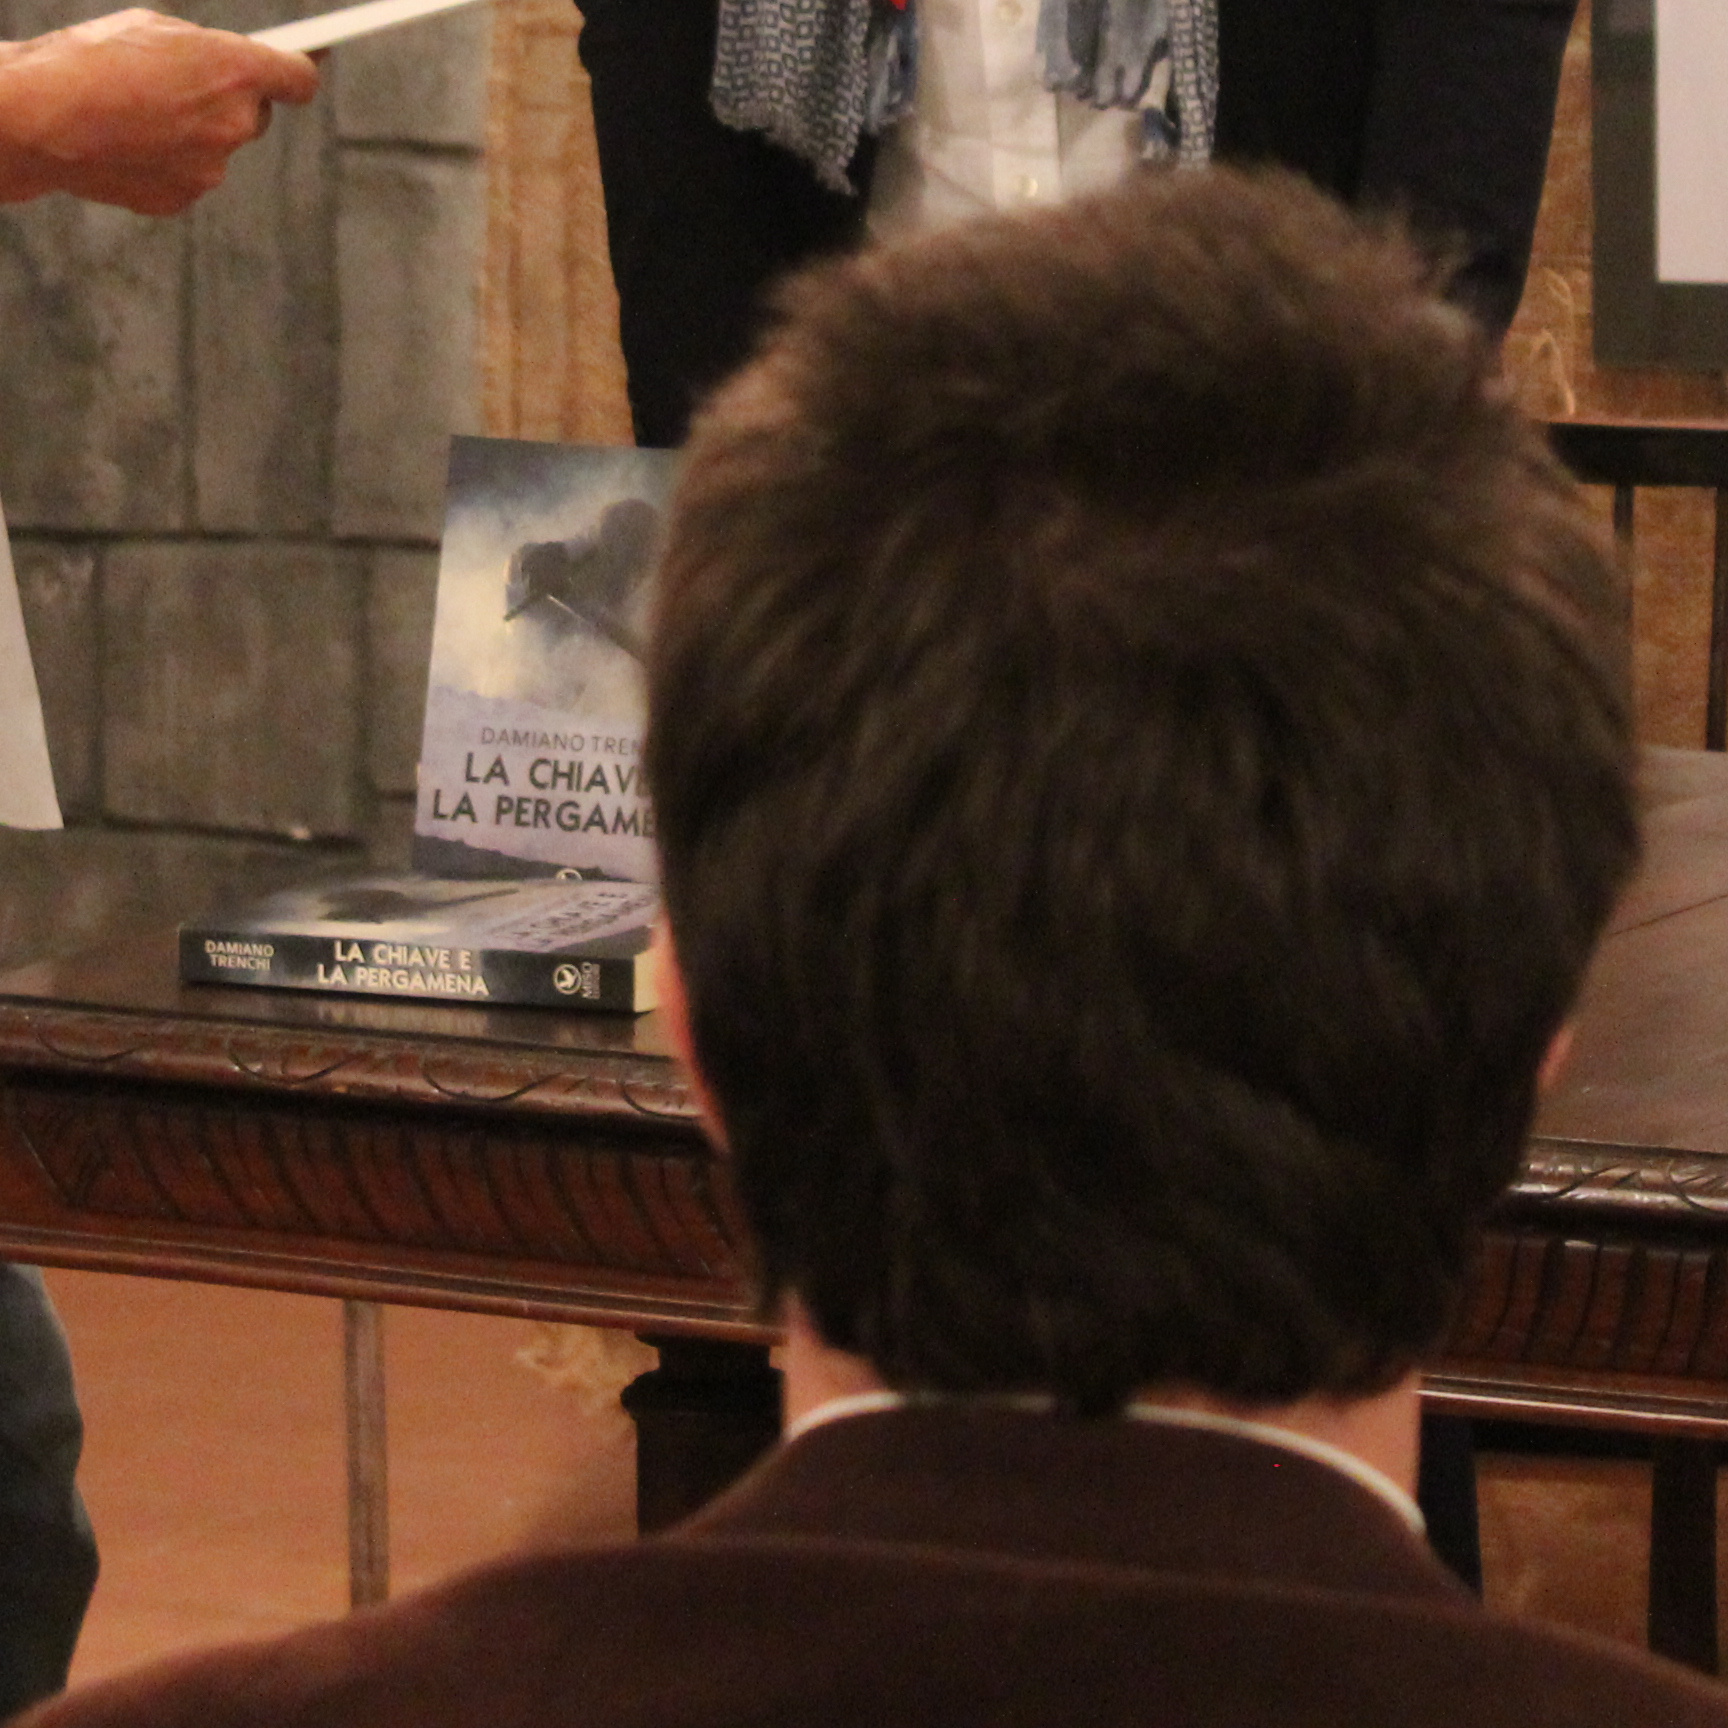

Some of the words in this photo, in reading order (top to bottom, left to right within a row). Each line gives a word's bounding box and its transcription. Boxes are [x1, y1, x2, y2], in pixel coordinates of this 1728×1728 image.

[481, 727, 585, 752] DAMIANO
[465, 752, 510, 786] LA
[432, 789, 478, 823] LA
[204, 939, 275, 958] DAMIANO
[210, 954, 271, 971] TRENCHI
[334, 940, 365, 963] LA
[374, 944, 450, 970] CHIAVE
[459, 951, 472, 971] E
[317, 963, 349, 985] LA
[354, 966, 490, 997] PERGAMENA
